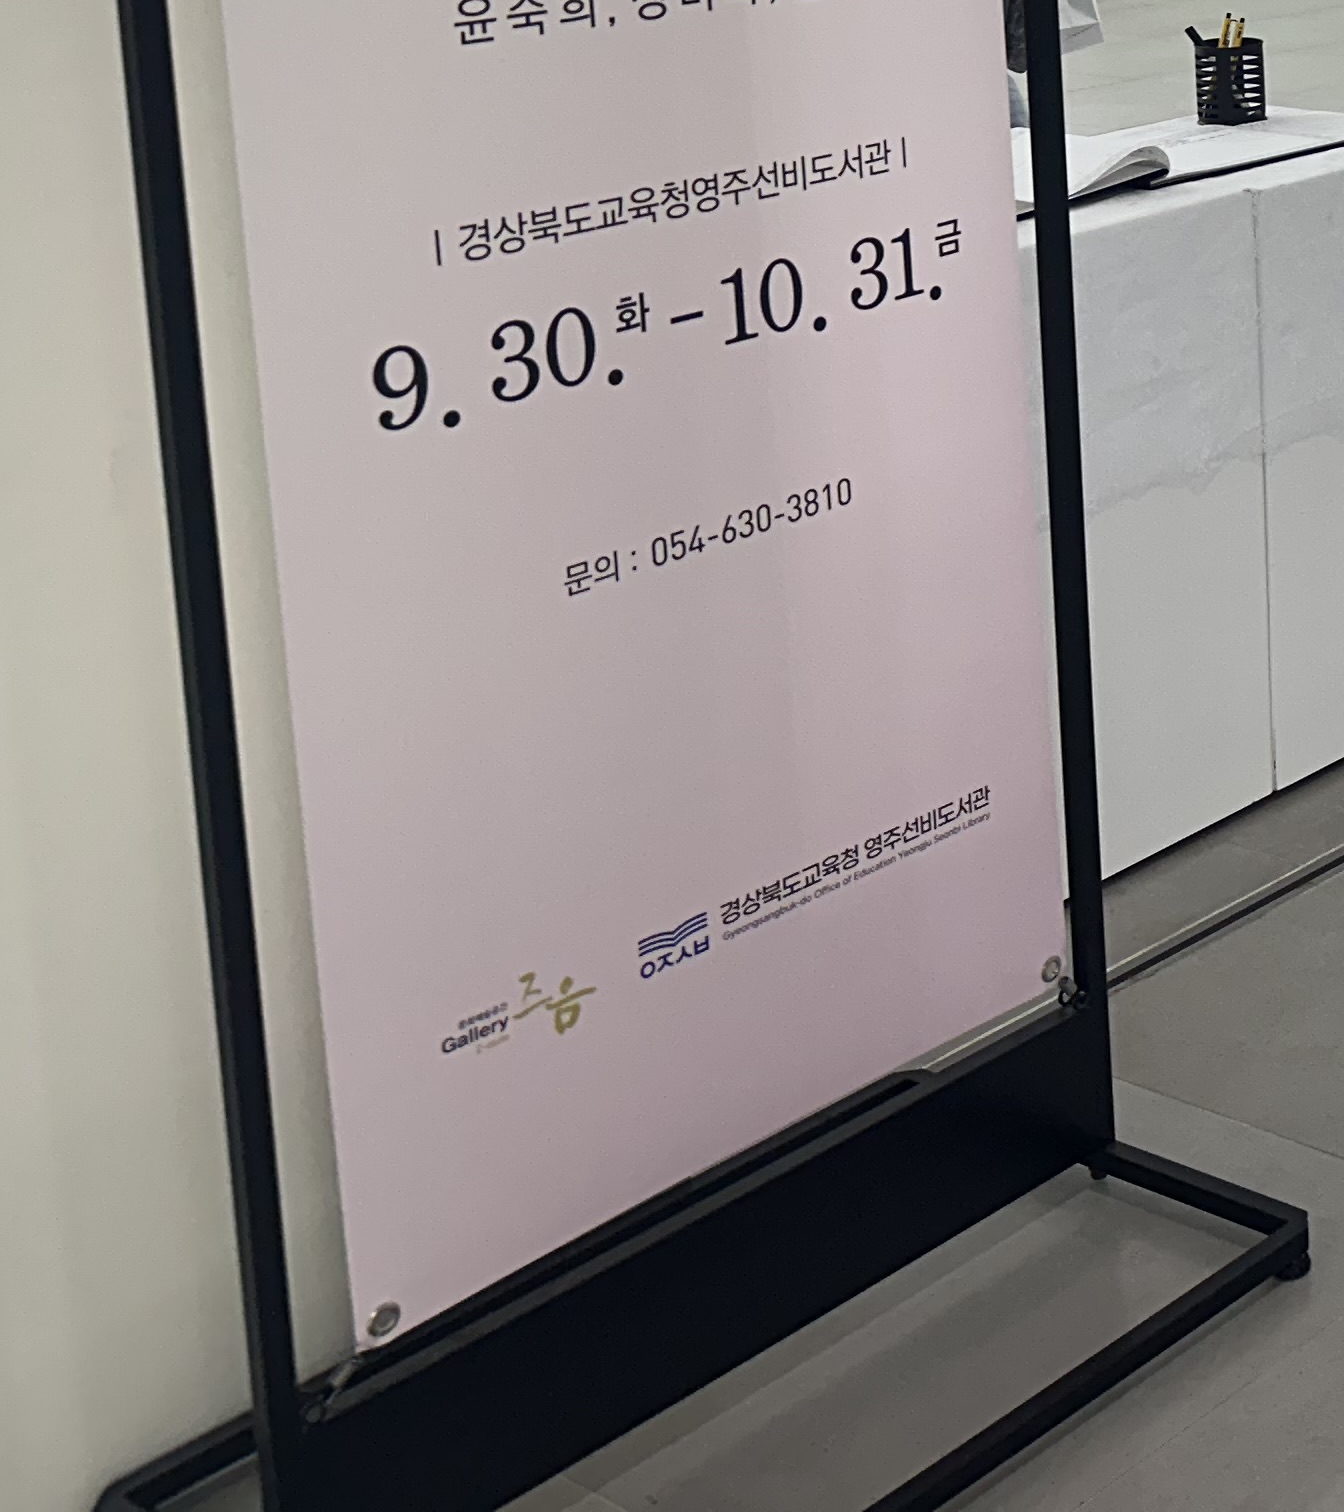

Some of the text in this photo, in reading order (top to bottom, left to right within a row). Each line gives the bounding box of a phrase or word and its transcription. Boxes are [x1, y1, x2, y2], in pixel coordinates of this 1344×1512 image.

[458, 142, 893, 261] 경상북도교육청영주선비도서관
[650, 477, 852, 567] 054-630-3810
[720, 785, 992, 925] 경상북도교육청 영주선비도서관
[813, 880, 841, 900] Office
[853, 855, 897, 881] Education
[440, 1015, 509, 1055] Gallery
